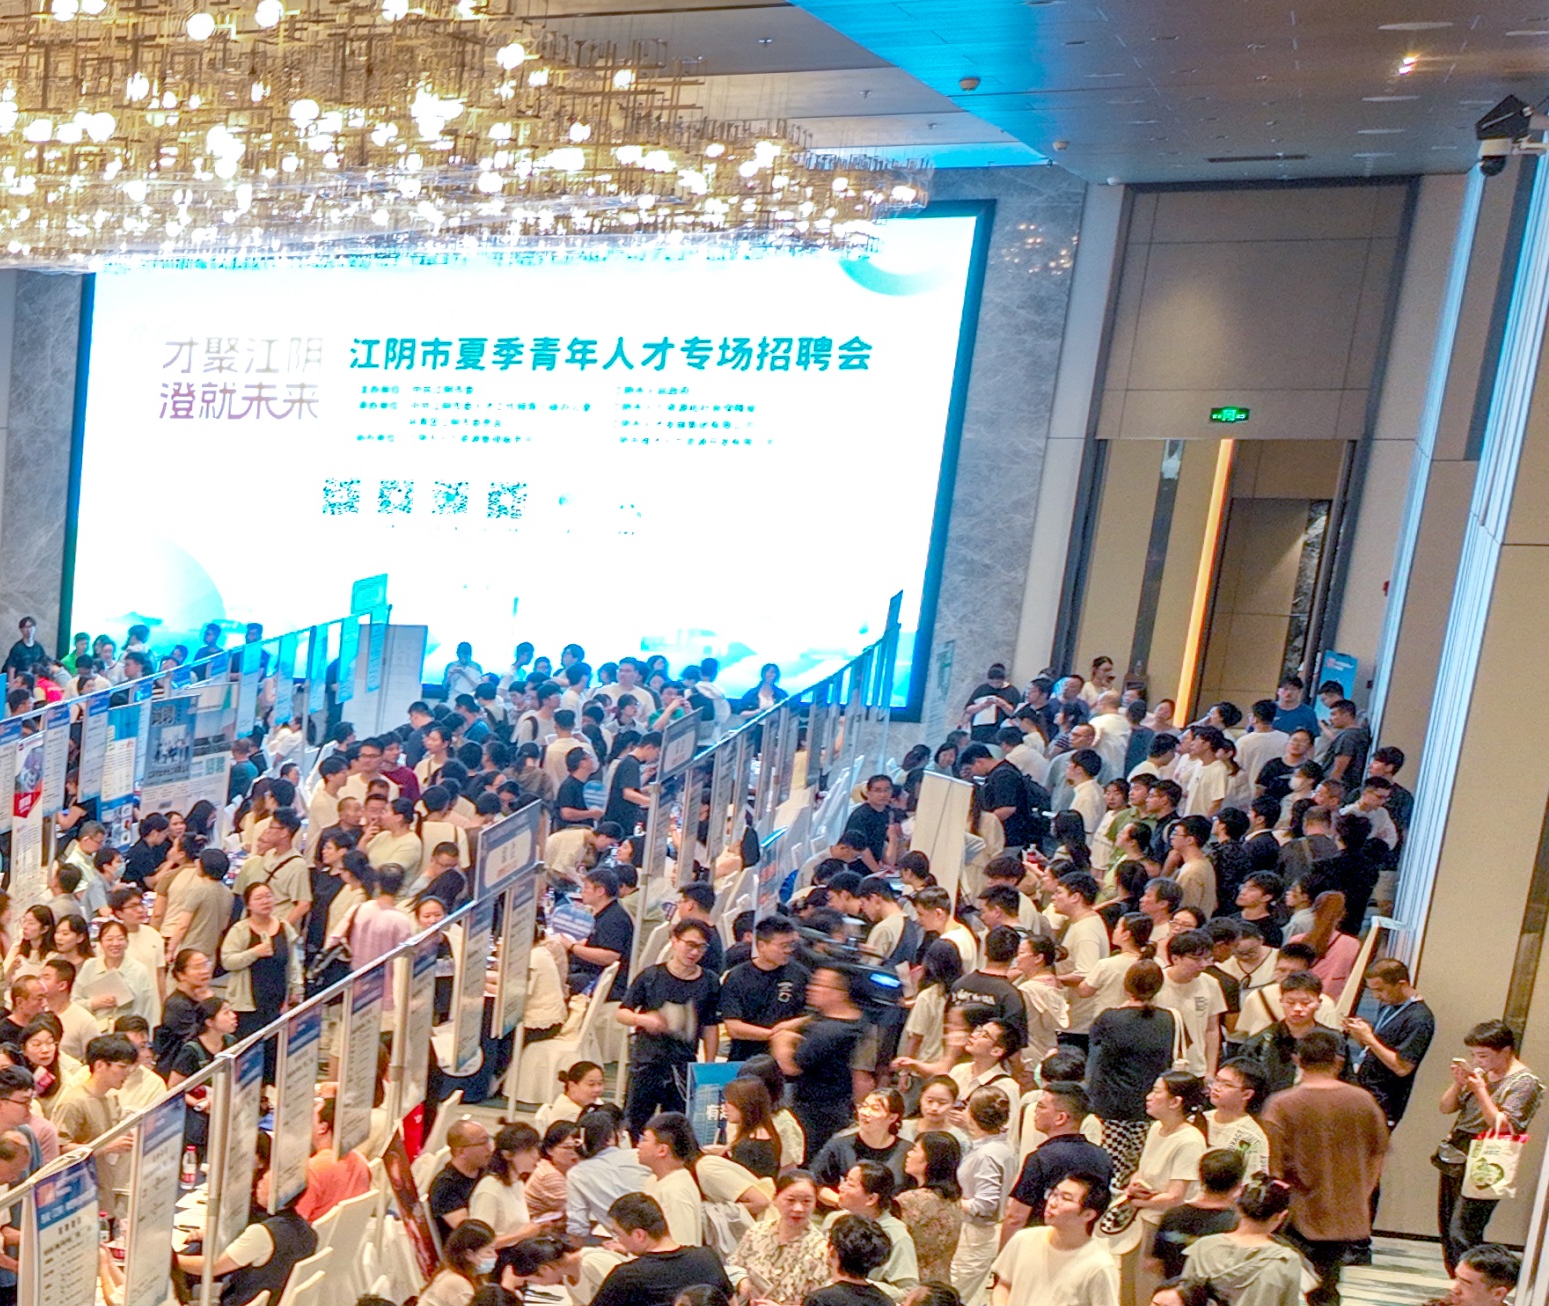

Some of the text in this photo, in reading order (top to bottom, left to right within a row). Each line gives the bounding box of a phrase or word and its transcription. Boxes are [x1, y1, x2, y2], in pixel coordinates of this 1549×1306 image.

[350, 336, 873, 372] 江阴市夏季青年人才专场招聘会
[158, 382, 319, 420] 澄就未来
